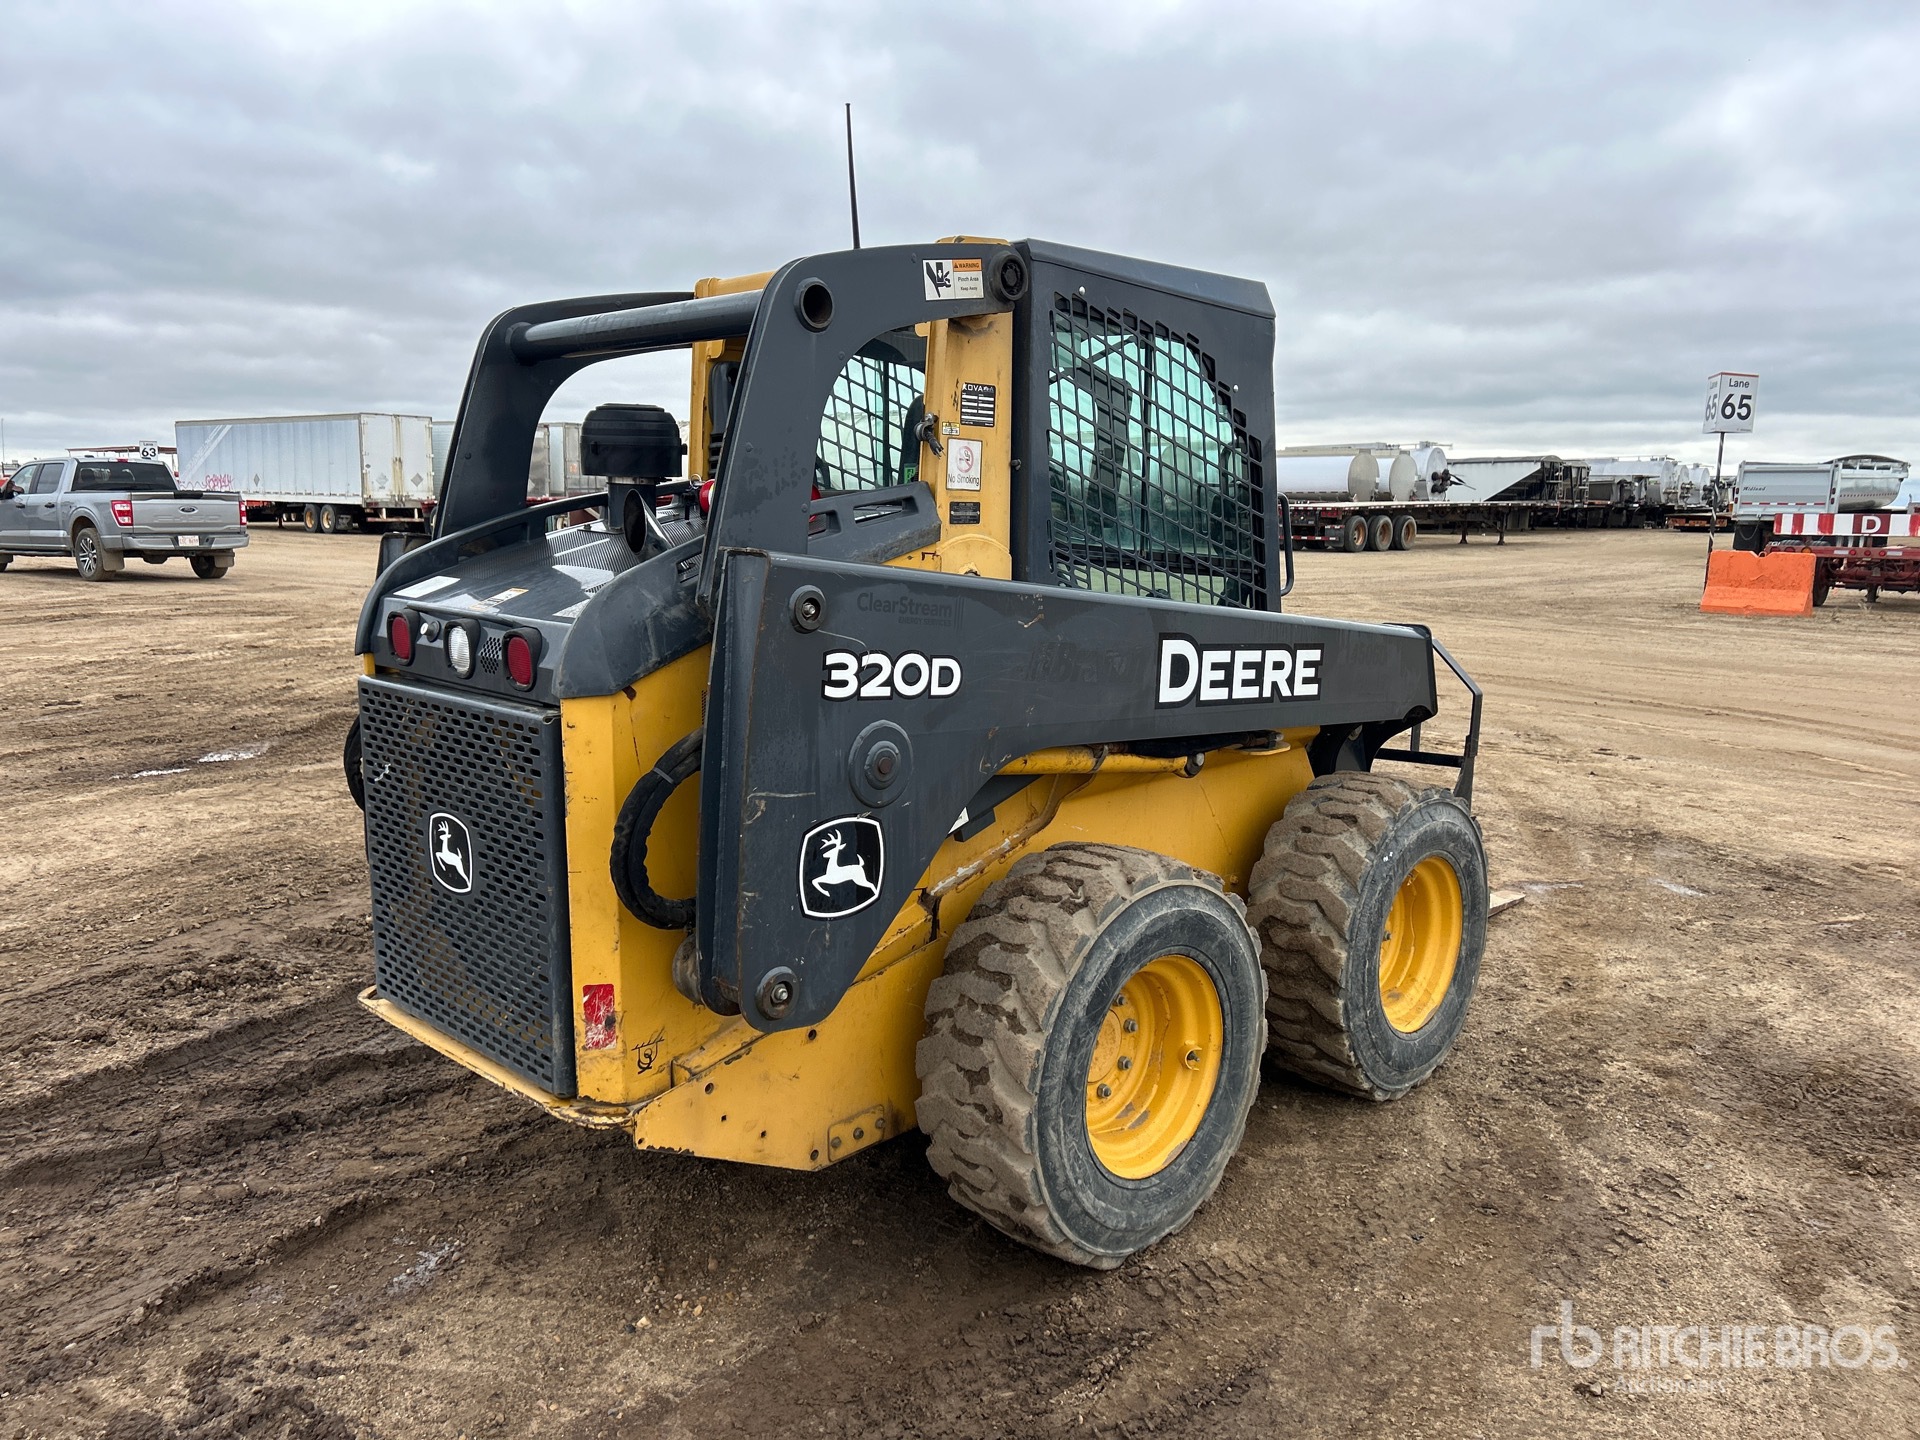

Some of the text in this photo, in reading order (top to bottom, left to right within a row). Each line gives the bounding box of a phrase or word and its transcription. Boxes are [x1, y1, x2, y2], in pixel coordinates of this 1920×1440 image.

[1729, 378, 1750, 388] Lane
[1705, 393, 1718, 421] 65
[1721, 393, 1752, 421] 65
[141, 447, 157, 457] 63
[948, 474, 980, 487] No Smoking
[1861, 515, 1882, 534] D
[857, 592, 953, 617] ClearStream
[824, 652, 962, 698] 320D
[1159, 639, 1322, 703] DEERE
